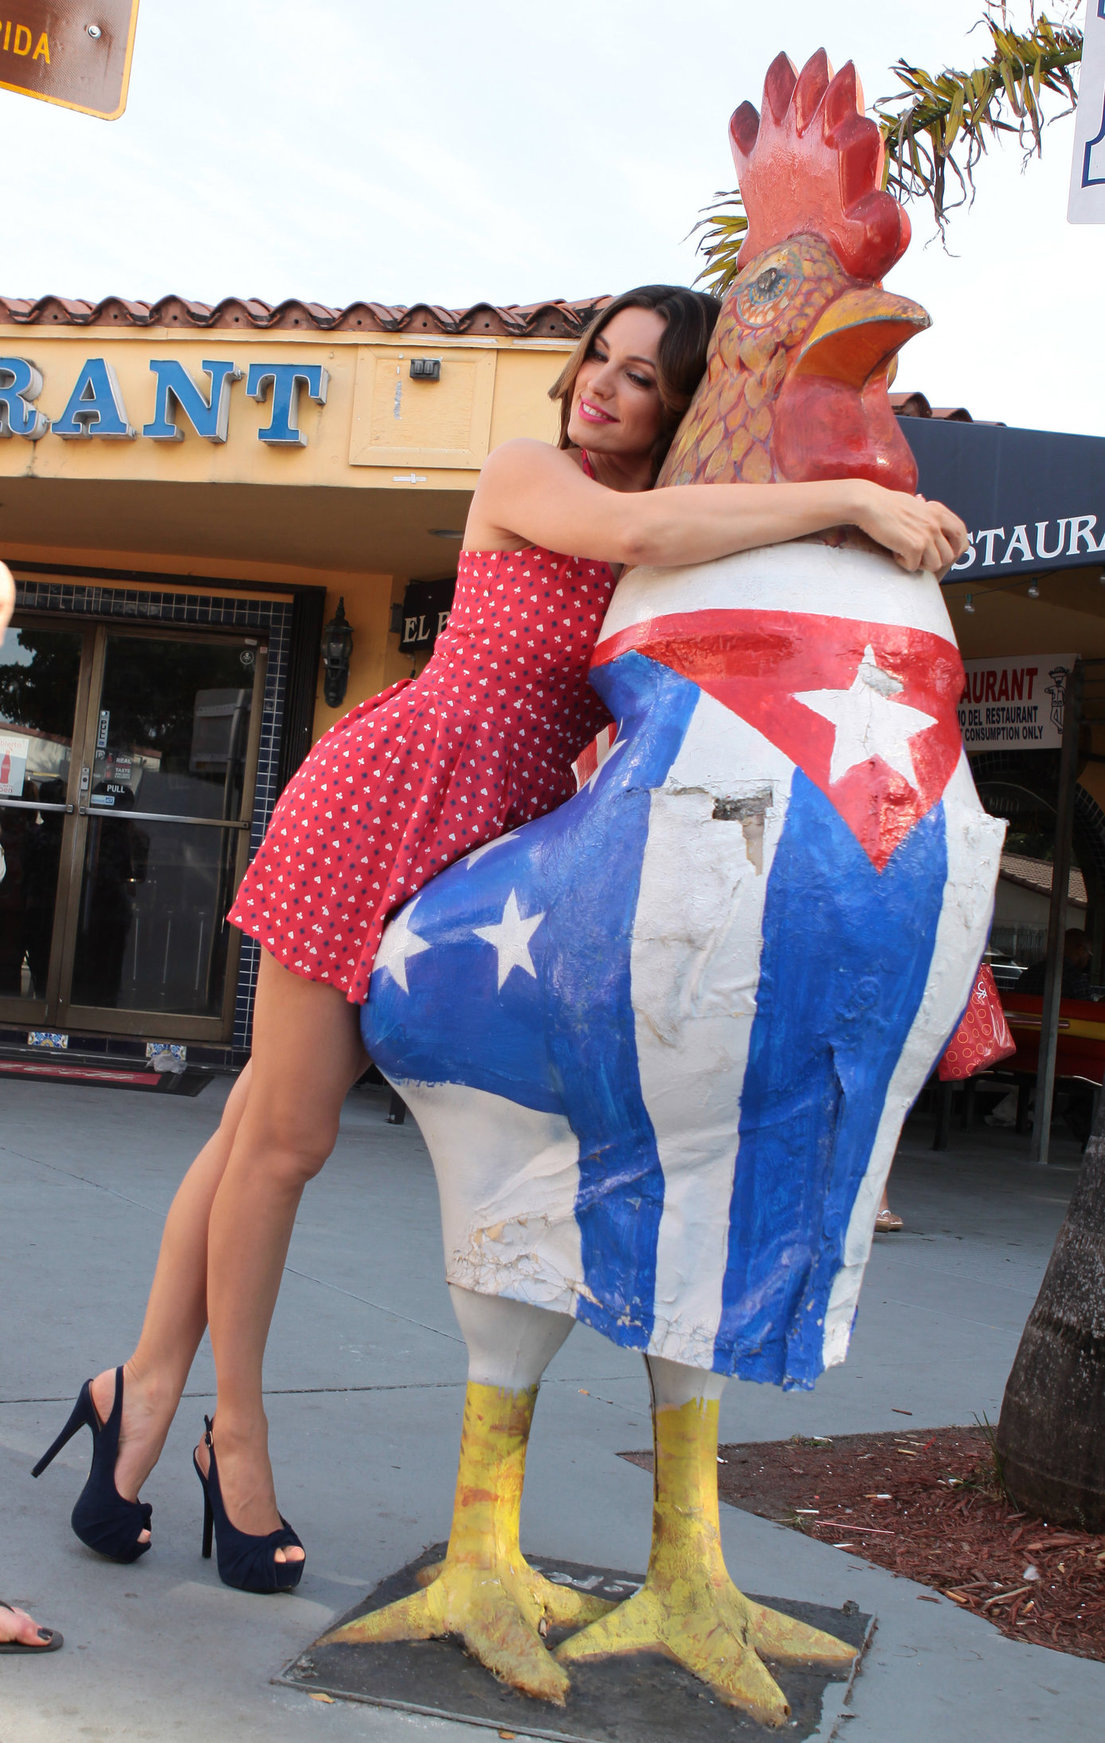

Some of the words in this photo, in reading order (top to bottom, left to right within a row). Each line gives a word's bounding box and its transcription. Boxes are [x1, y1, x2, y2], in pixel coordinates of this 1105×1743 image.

[951, 515, 1105, 571] STAUR
[402, 615, 430, 642] EL
[968, 709, 982, 726] DEL
[986, 706, 1038, 724] RESTAURANT
[965, 727, 1020, 742] CONSUMPTION
[1022, 726, 1043, 740] ONLY
[106, 784, 125, 794] PULL
